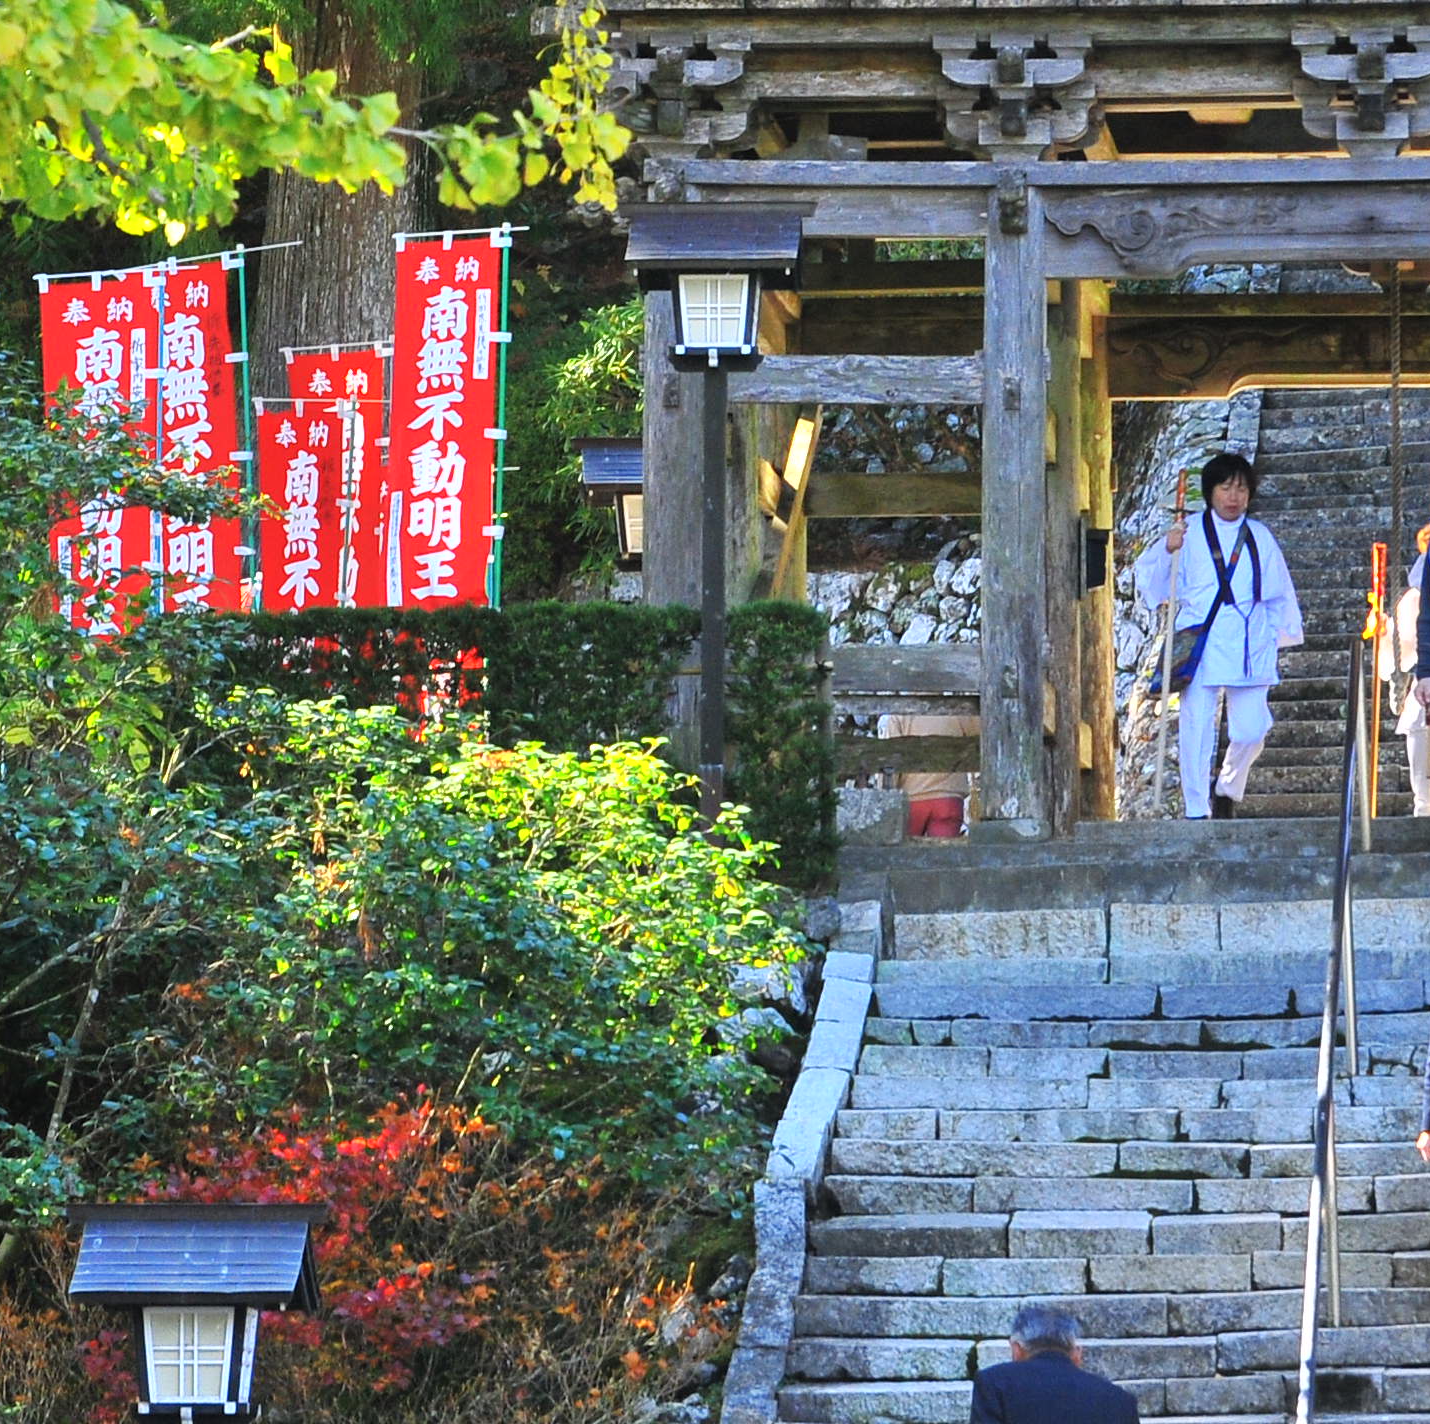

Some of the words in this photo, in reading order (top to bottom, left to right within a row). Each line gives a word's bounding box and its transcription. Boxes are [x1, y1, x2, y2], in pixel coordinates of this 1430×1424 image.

[415, 256, 480, 284] 奉納
[61, 296, 134, 327] 奉納
[308, 368, 369, 396] 奉納
[275, 419, 330, 449] 奉納
[407, 286, 470, 601] 南無不動明王
[279, 450, 322, 615] 南無不
